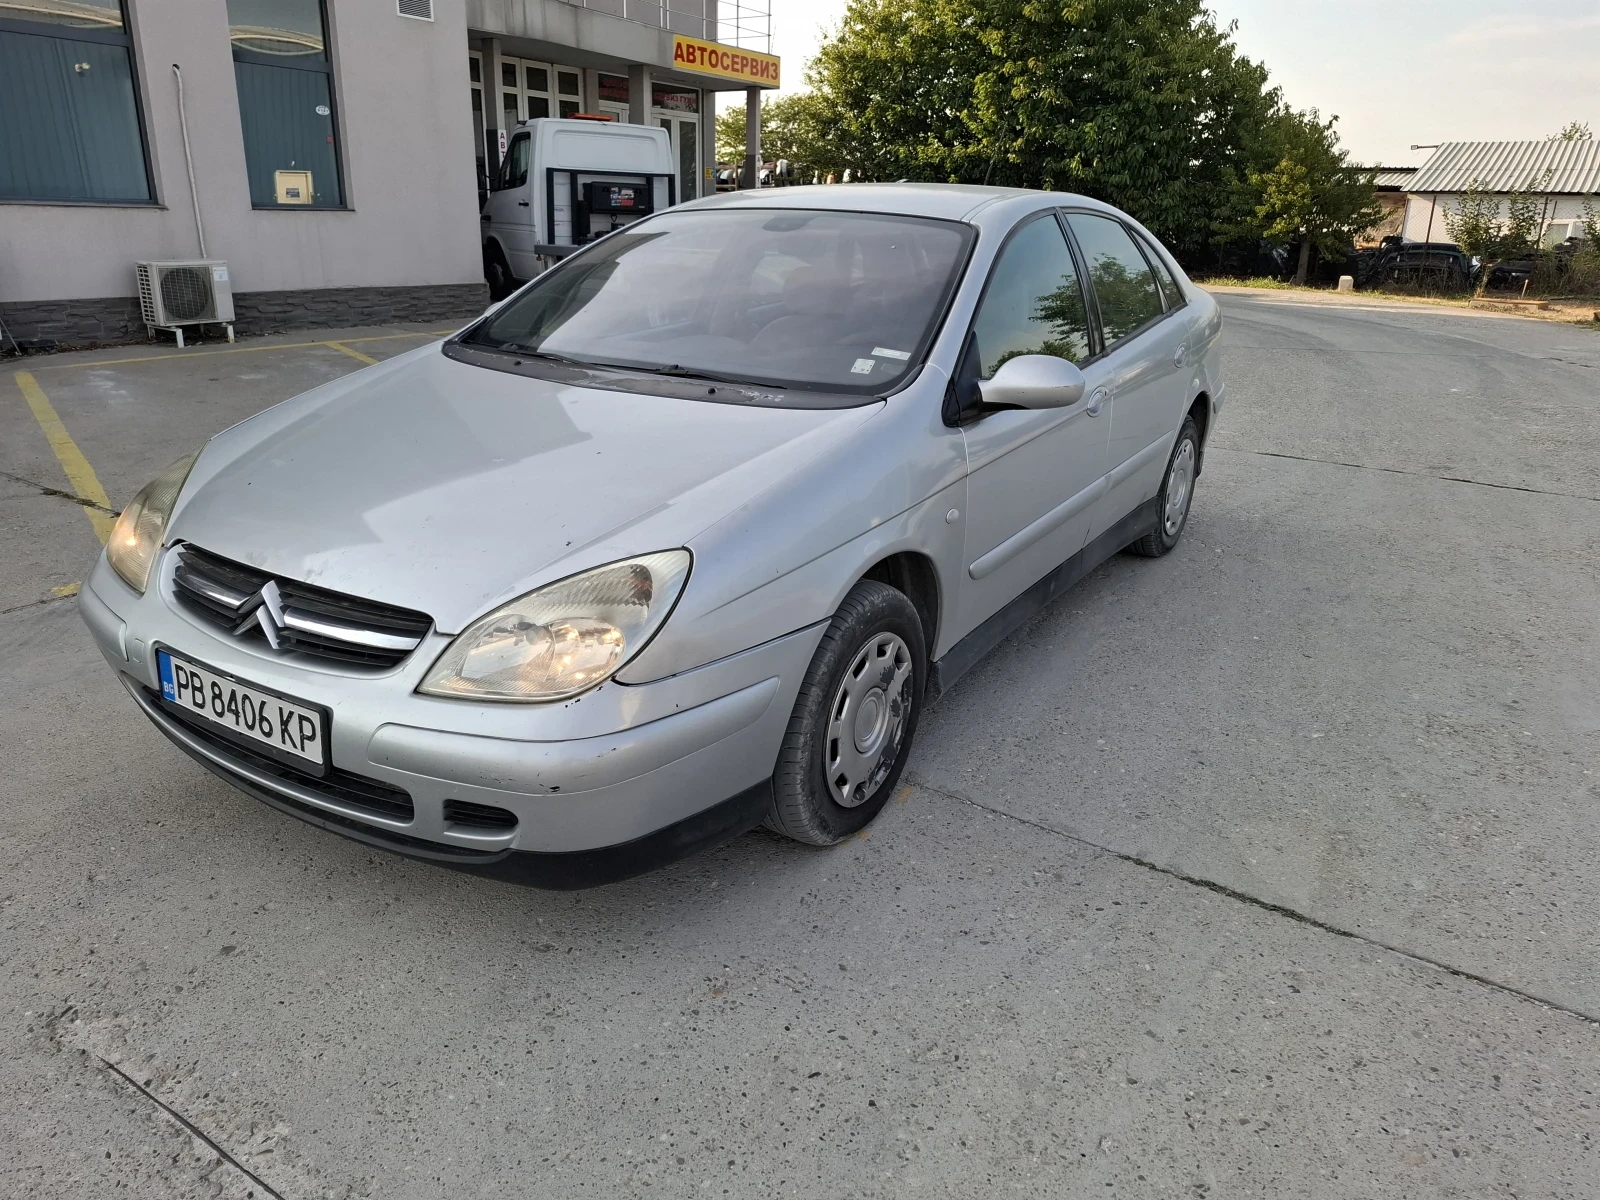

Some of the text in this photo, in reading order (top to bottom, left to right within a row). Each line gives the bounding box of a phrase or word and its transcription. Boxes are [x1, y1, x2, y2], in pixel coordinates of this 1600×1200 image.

[674, 42, 778, 80] АВТОСЕРВИЗ
[164, 681, 174, 695] BG
[174, 663, 317, 753] PB 8406 KP
